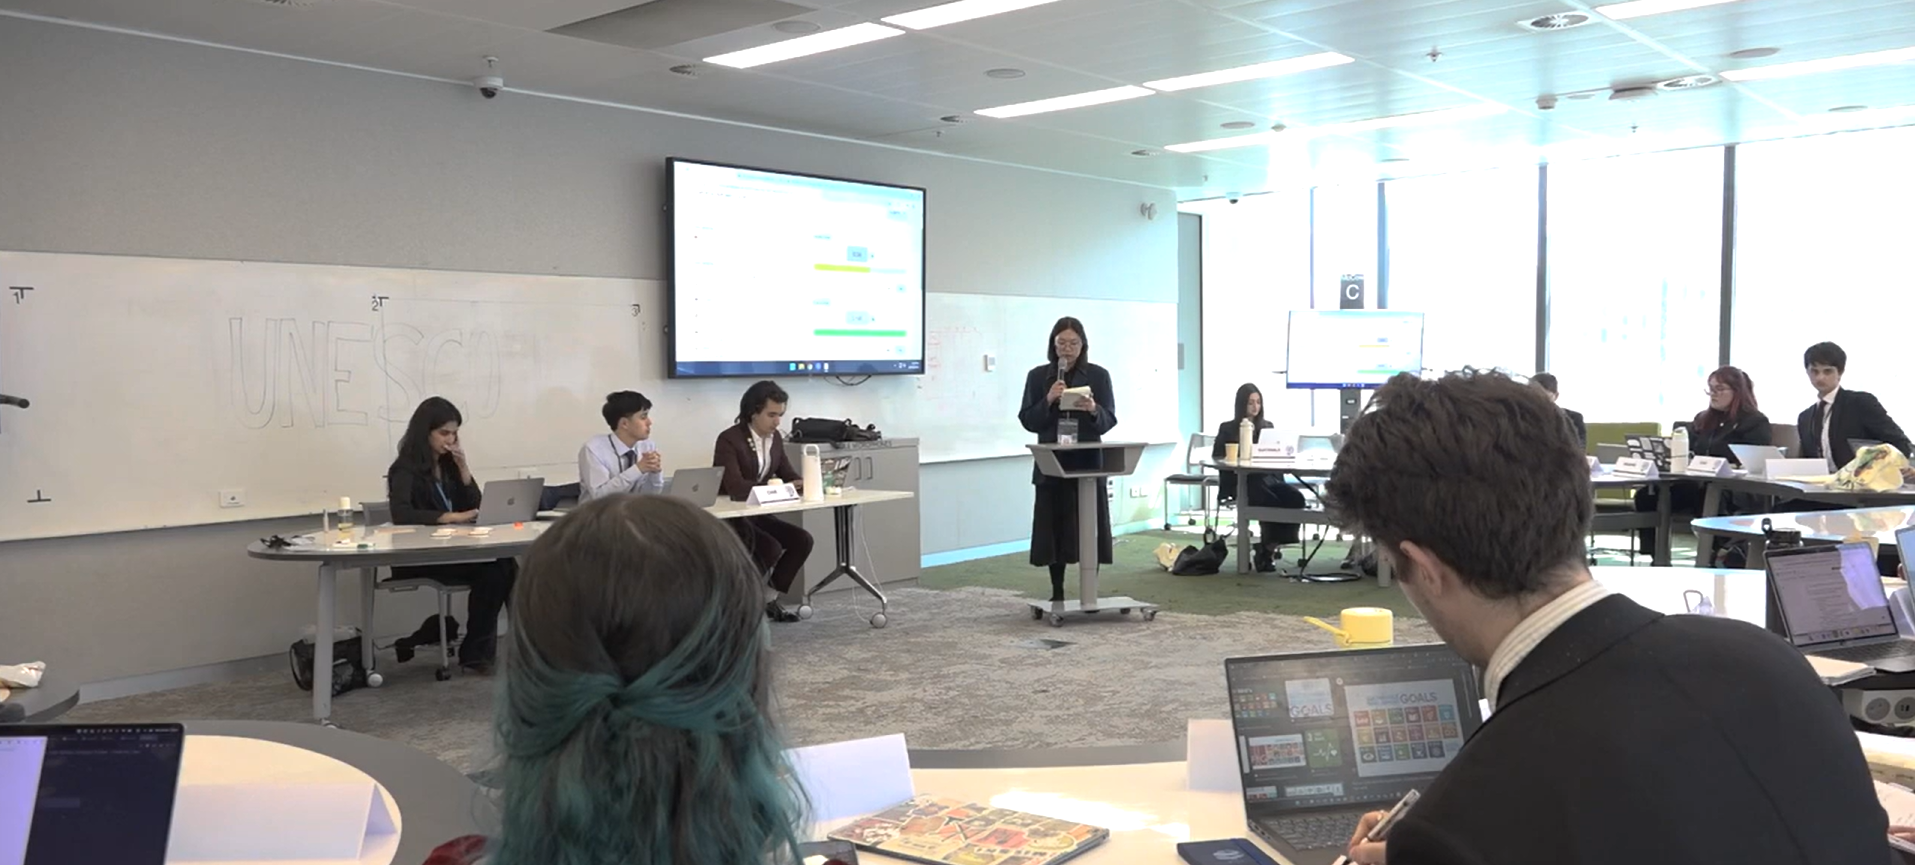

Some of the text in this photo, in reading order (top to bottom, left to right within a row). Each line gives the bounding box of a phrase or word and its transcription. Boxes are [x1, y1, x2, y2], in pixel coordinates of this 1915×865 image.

[1346, 284, 1360, 300] C
[371, 299, 379, 312] 2
[631, 307, 639, 317] 3
[229, 317, 501, 430] UNESCO
[1399, 692, 1438, 705] GOALS
[1290, 703, 1333, 717] GOALS
